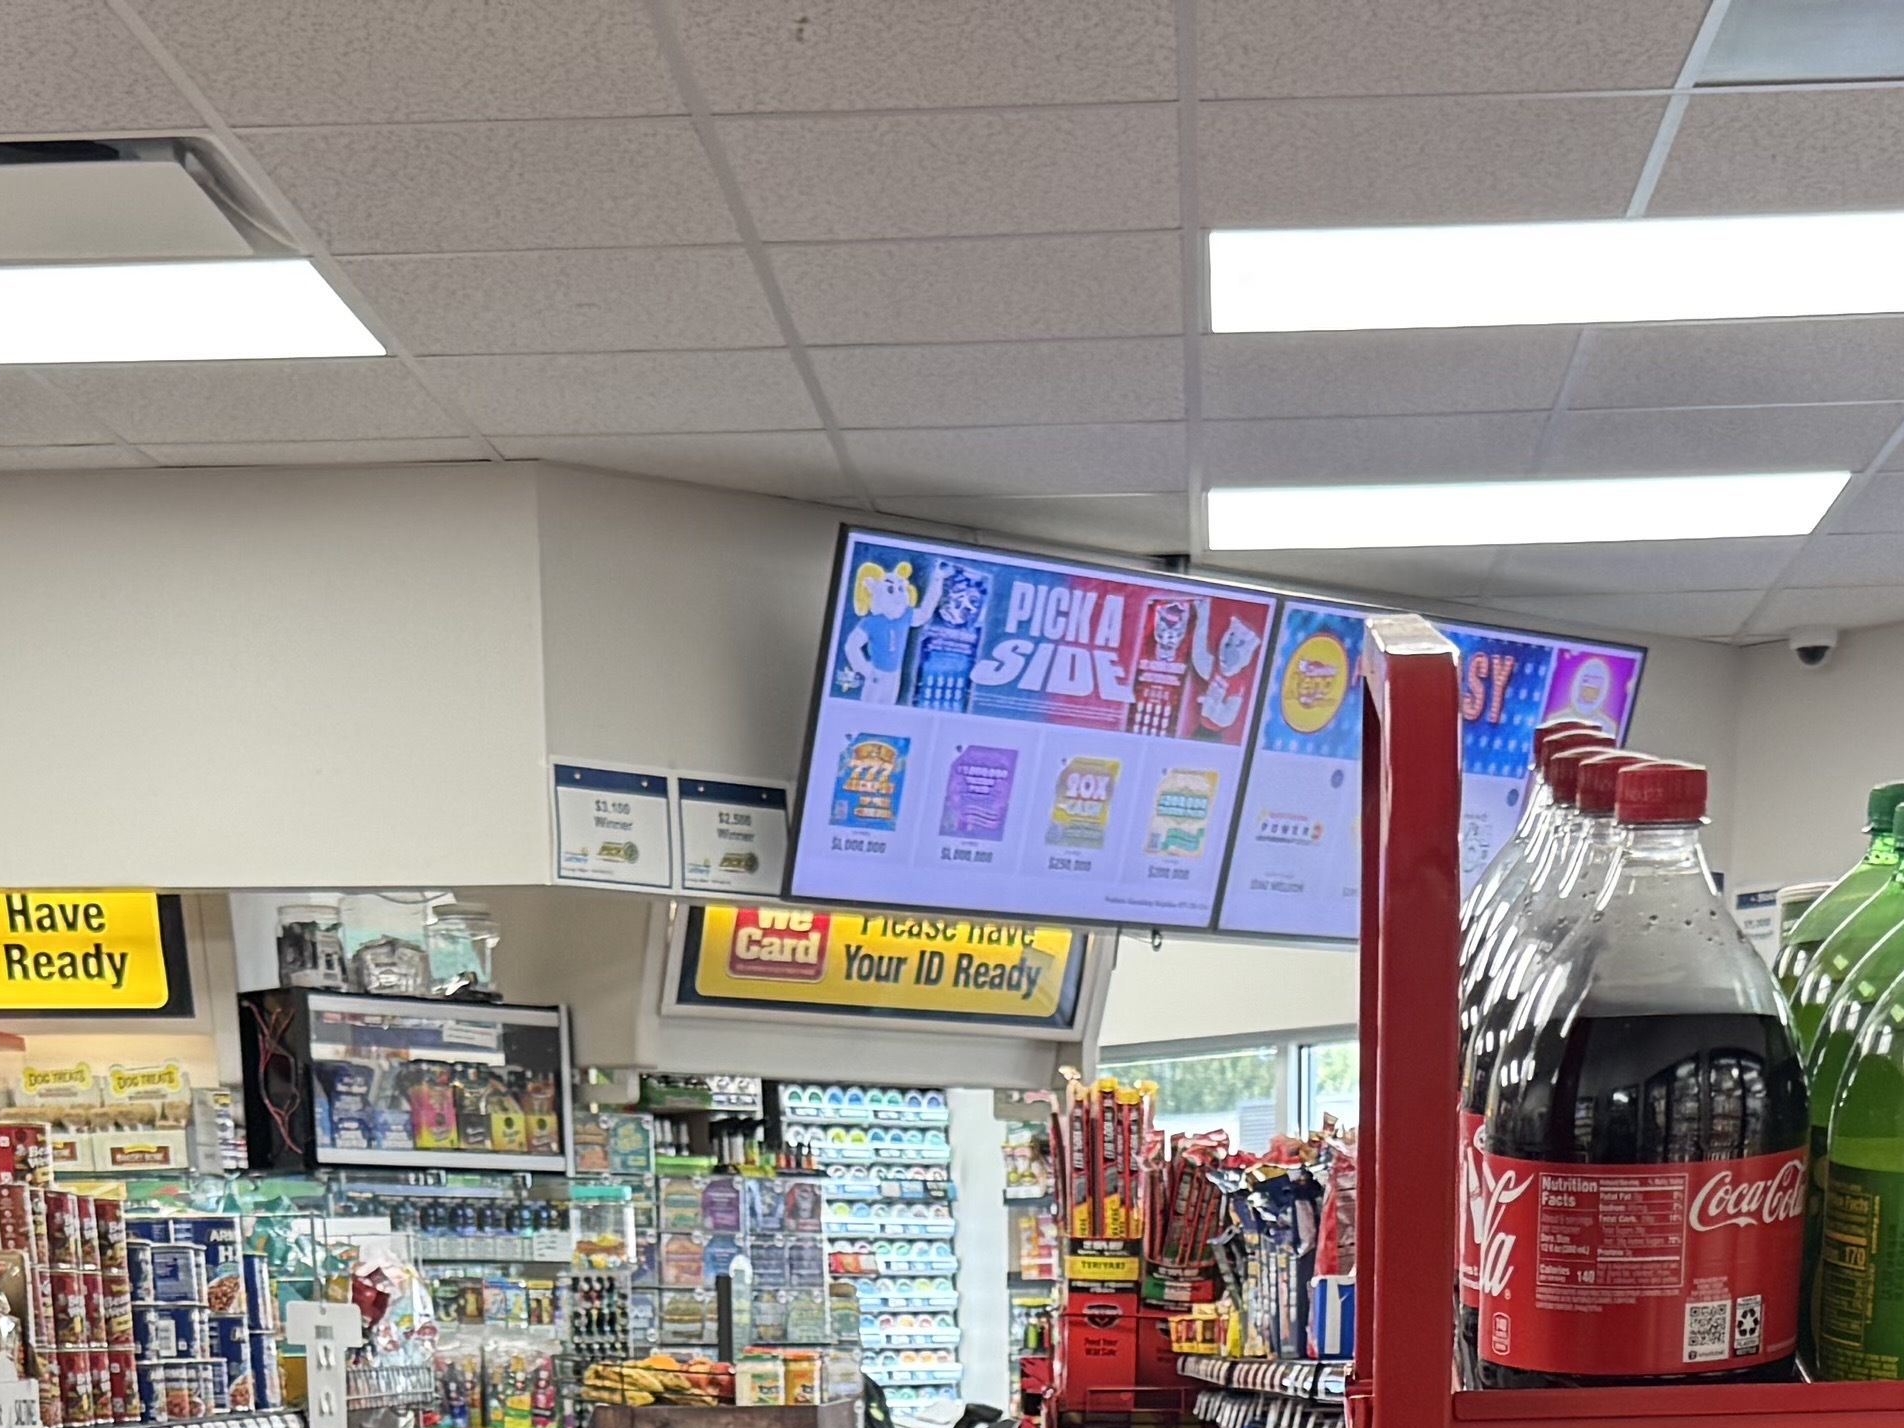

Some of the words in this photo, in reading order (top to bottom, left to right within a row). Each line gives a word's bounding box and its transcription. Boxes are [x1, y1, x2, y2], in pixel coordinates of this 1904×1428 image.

[1005, 581, 1098, 644] PICK
[1095, 595, 1125, 648] A
[970, 639, 1136, 703] SIDE
[7, 894, 106, 934] Have
[735, 926, 821, 965] Card
[4, 943, 129, 988] Ready
[843, 944, 908, 983] Your
[915, 949, 944, 987] ID
[953, 952, 1042, 1000] Ready
[29, 1071, 52, 1087] DOG
[53, 1069, 86, 1085] TREATS
[117, 1073, 140, 1090] DOG
[139, 1071, 175, 1087] TREATS
[1542, 1176, 1597, 1193] Nutrition
[1542, 1191, 1576, 1207] Facts
